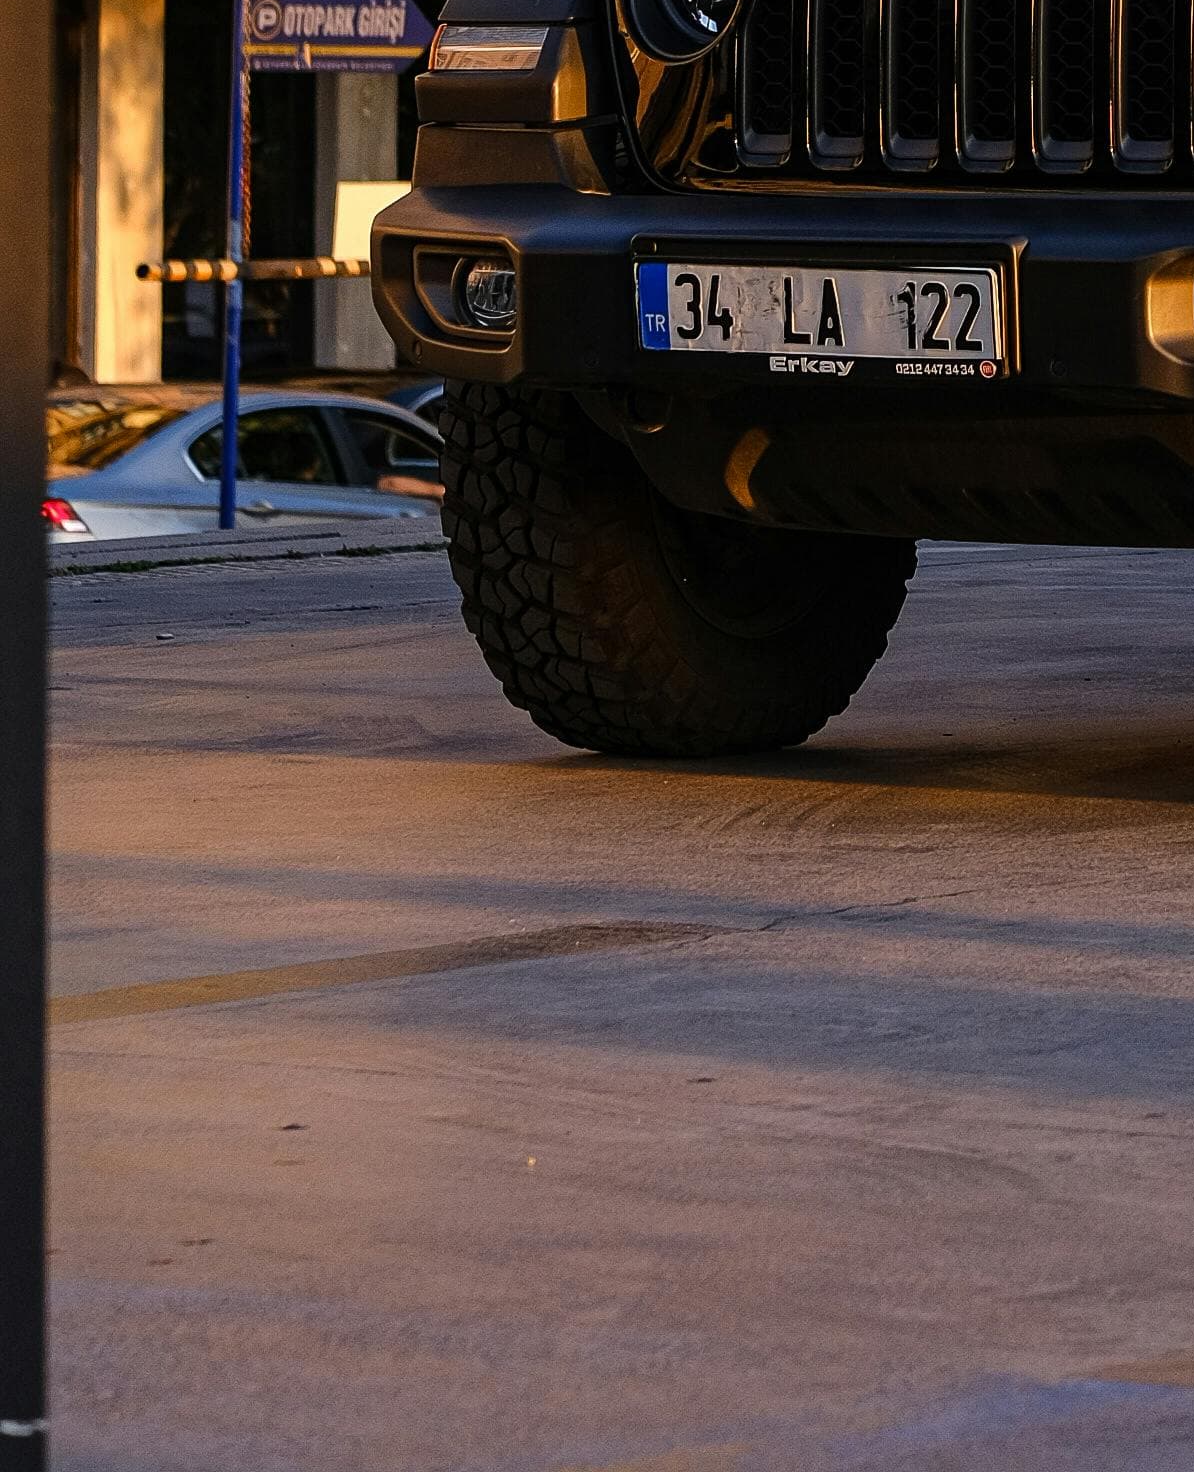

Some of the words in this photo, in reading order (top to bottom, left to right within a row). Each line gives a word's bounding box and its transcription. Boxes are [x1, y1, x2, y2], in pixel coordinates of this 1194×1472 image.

[284, 4, 356, 37] OTOPARK
[645, 313, 665, 333] TR
[675, 272, 734, 341] 34
[783, 276, 845, 348] LA
[896, 281, 983, 352] 122
[769, 356, 854, 376] Erkay
